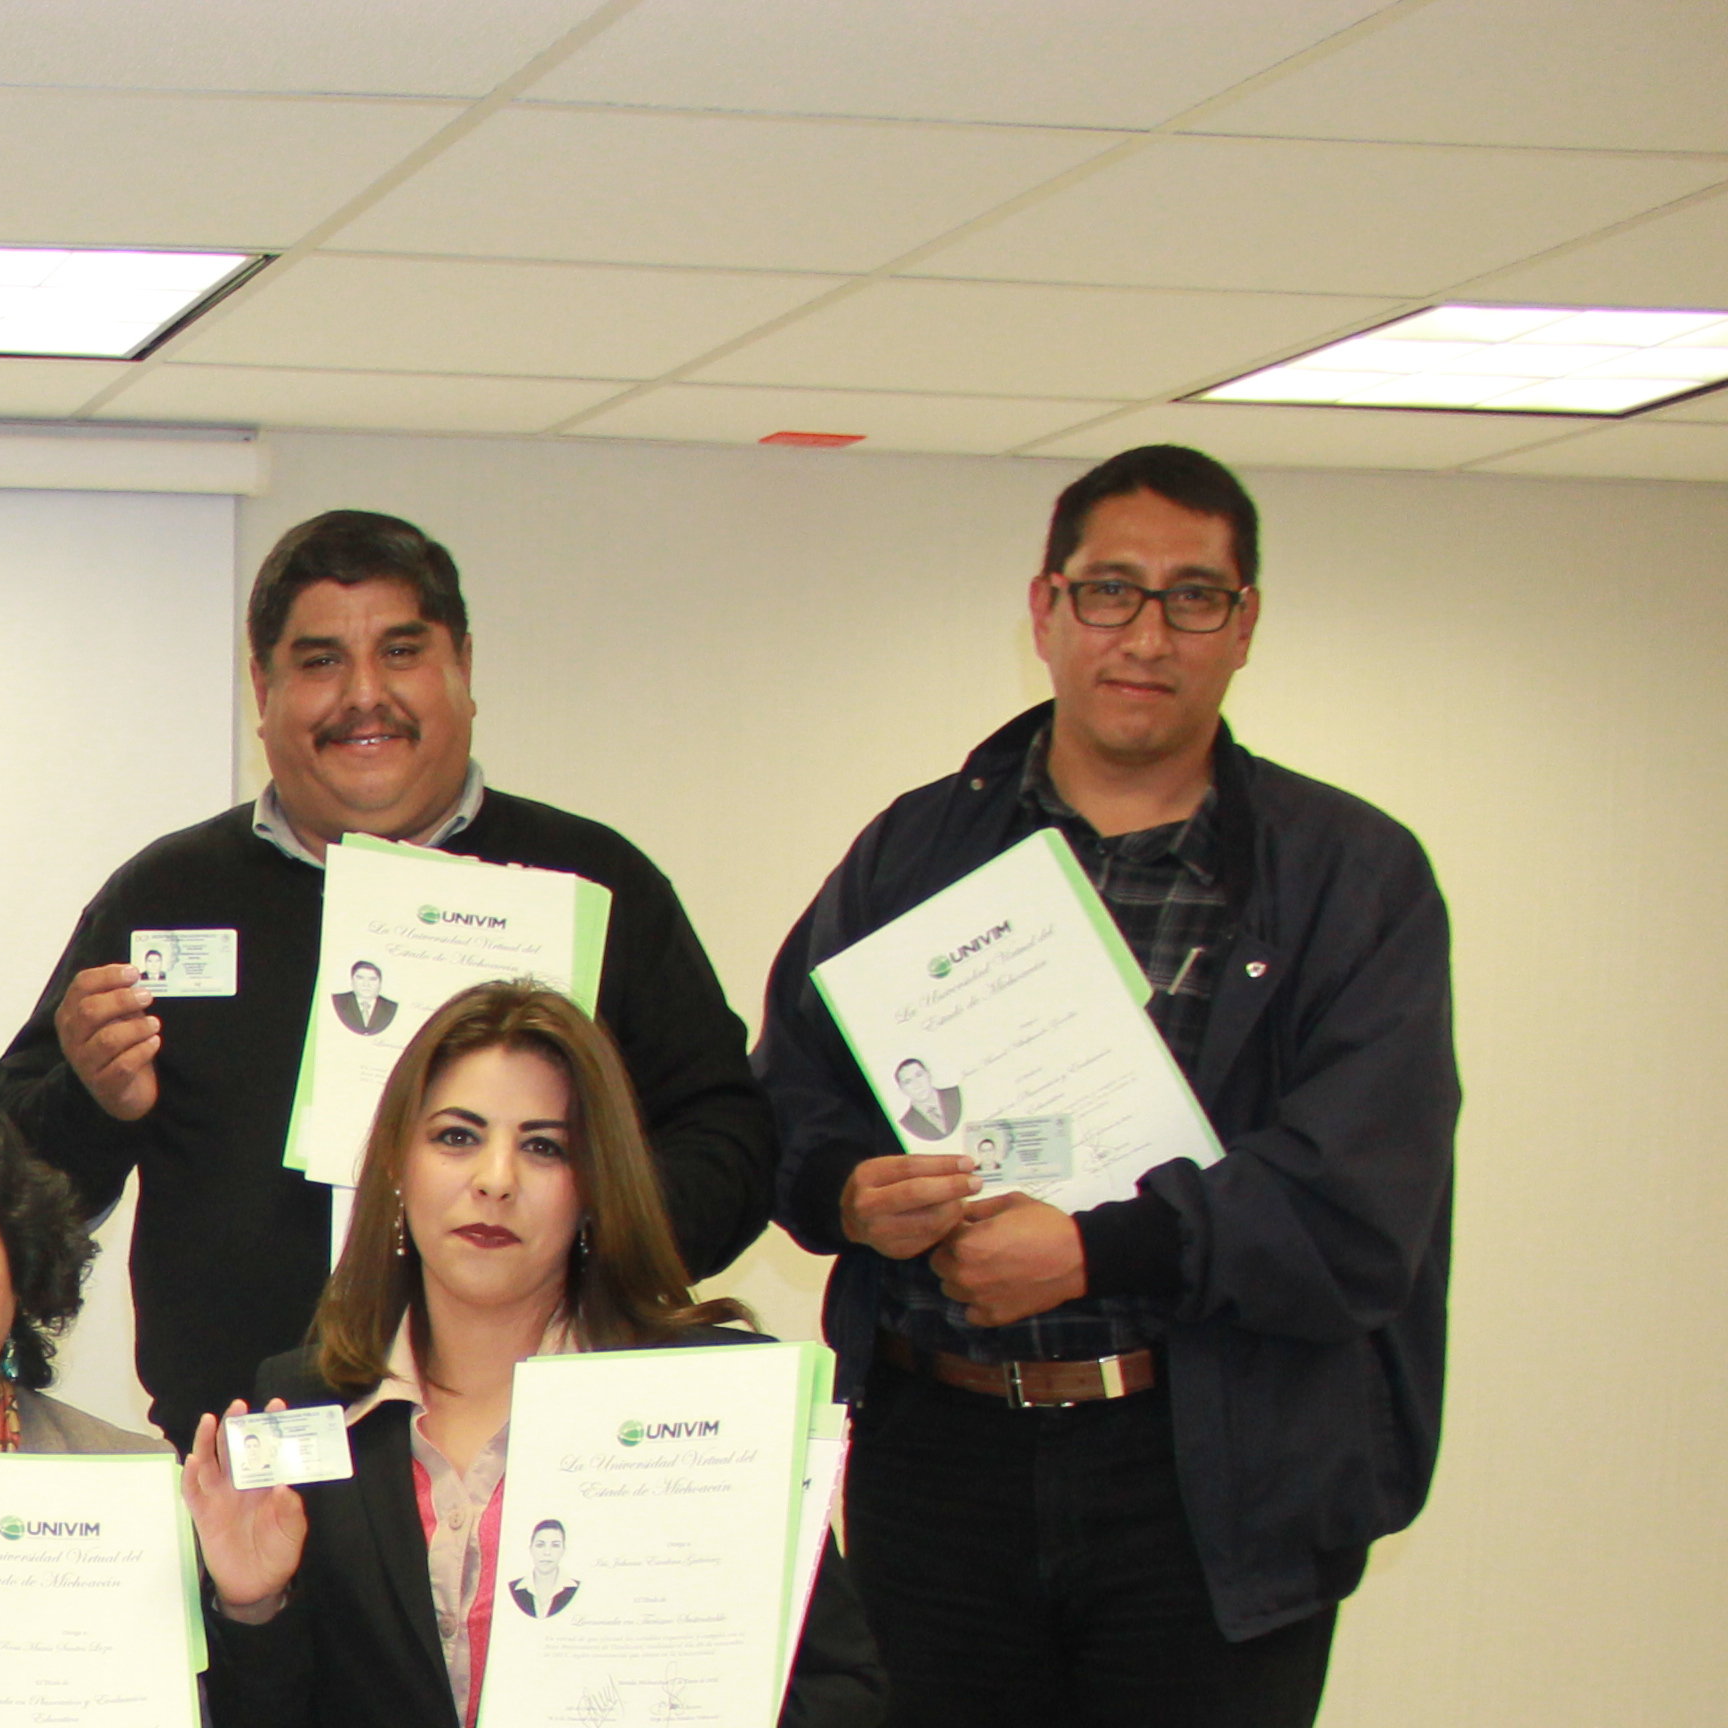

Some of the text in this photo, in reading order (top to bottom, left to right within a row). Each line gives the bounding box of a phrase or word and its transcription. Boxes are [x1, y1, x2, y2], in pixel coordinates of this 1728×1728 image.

[442, 910, 507, 929] UNIVIM
[949, 919, 1012, 964] UNIVIM
[646, 1420, 720, 1439] UNIVIM
[589, 1454, 680, 1472] Universidad
[681, 1447, 736, 1468] Virtual
[736, 1449, 758, 1463] del
[579, 1476, 732, 1499] Estado de Michoacán
[26, 1521, 101, 1537] UNIVIM
[65, 1546, 121, 1564] Virtual
[121, 1549, 144, 1563] del
[20, 1574, 37, 1588] de
[40, 1571, 121, 1588] Michoacán
